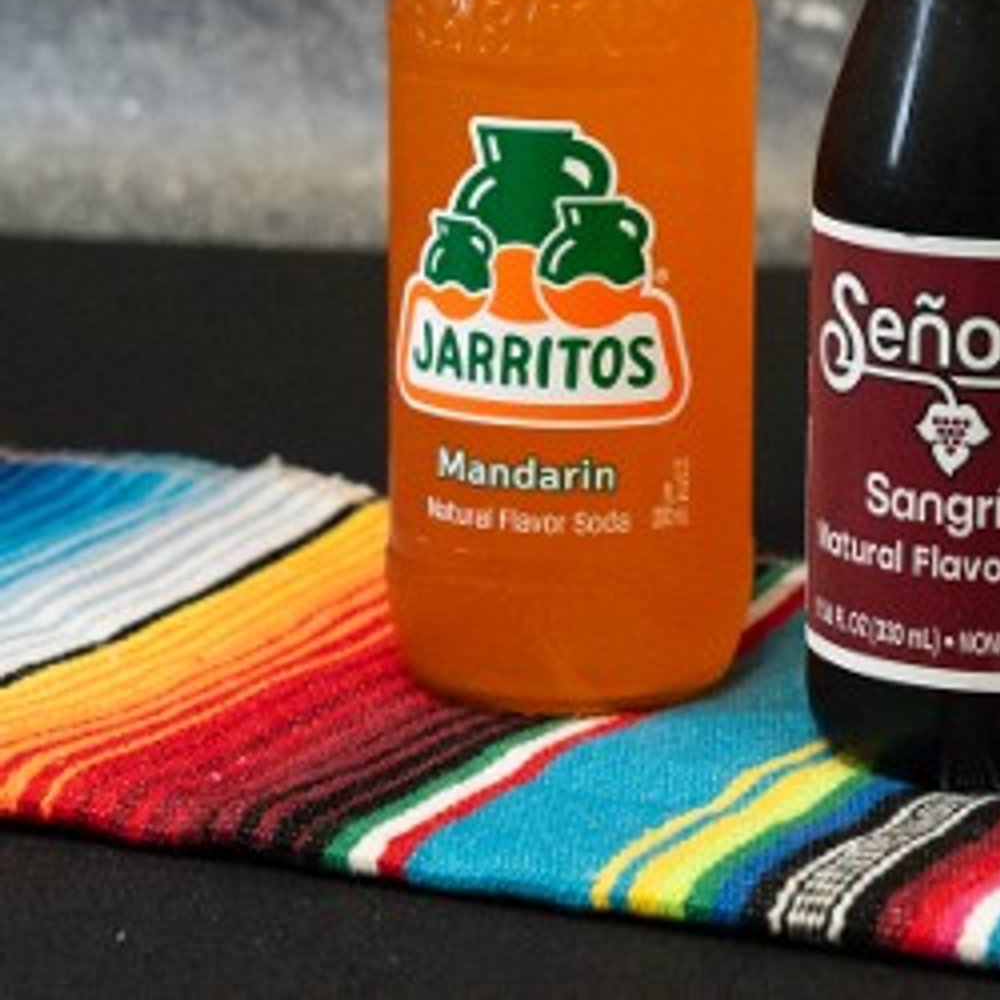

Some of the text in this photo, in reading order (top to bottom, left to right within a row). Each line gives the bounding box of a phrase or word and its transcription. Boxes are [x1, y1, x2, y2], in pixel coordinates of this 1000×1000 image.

[412, 322, 656, 390] JARRITOS
[437, 446, 617, 492] Mandarin
[427, 495, 632, 536] Natural Flavor Soda
[817, 520, 902, 573] Natural
